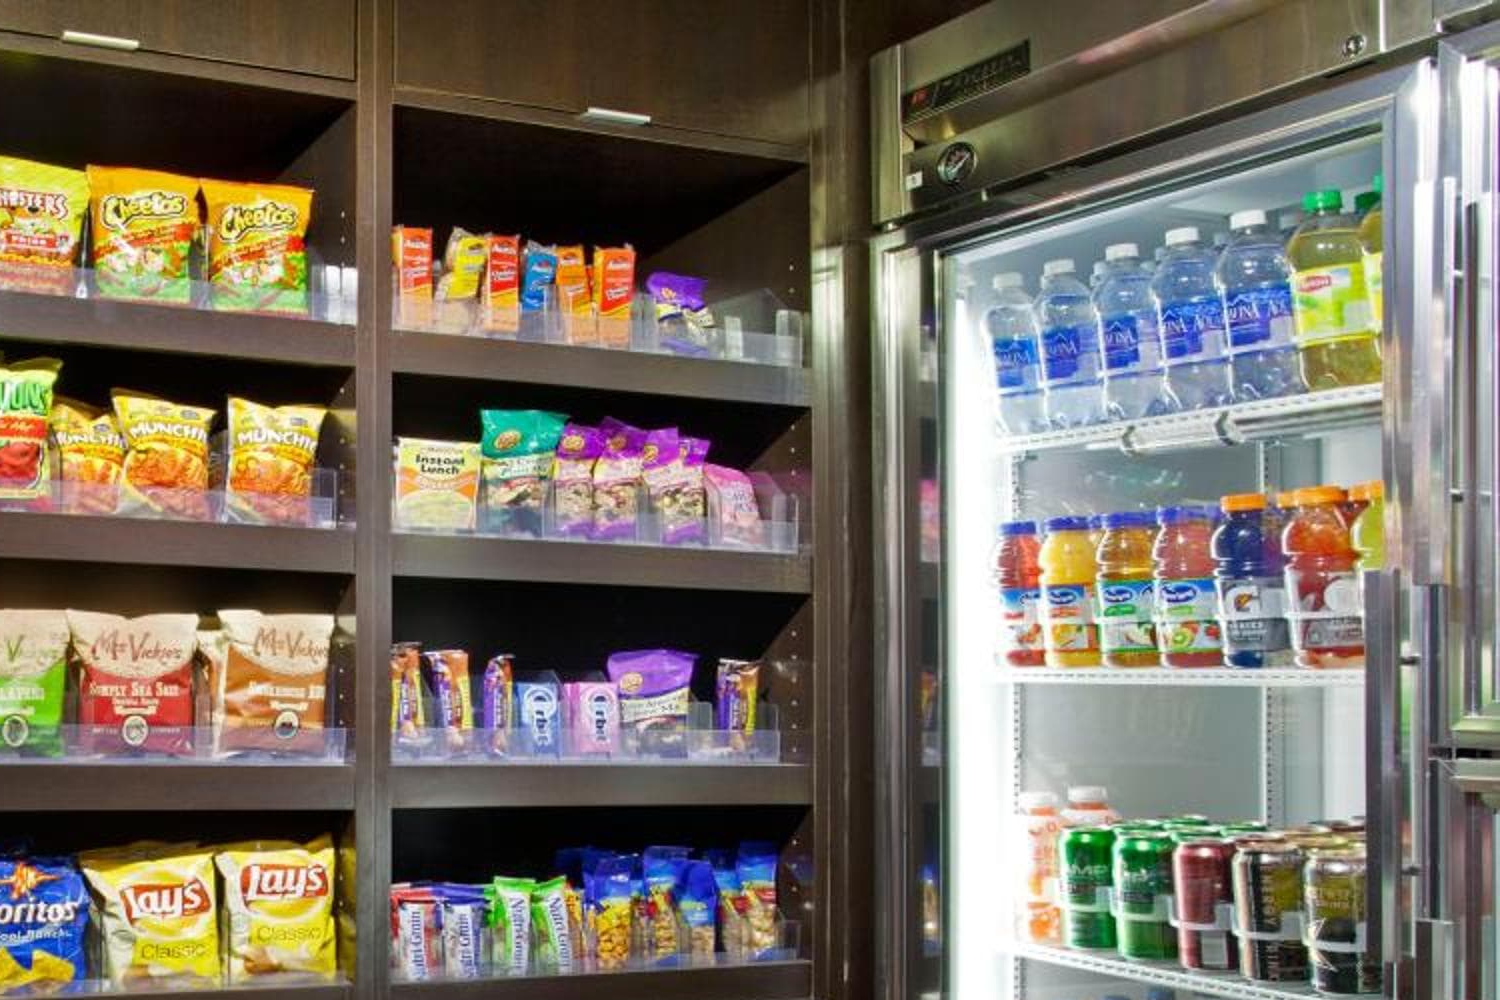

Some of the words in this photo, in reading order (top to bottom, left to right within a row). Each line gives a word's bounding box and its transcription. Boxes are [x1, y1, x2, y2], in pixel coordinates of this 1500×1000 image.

[103, 193, 186, 228] Cheetos
[221, 202, 297, 240] Cheetos
[416, 454, 464, 465] Instant
[421, 465, 460, 475] Lunch
[257, 924, 321, 943] Classic
[142, 943, 206, 961] Classic
